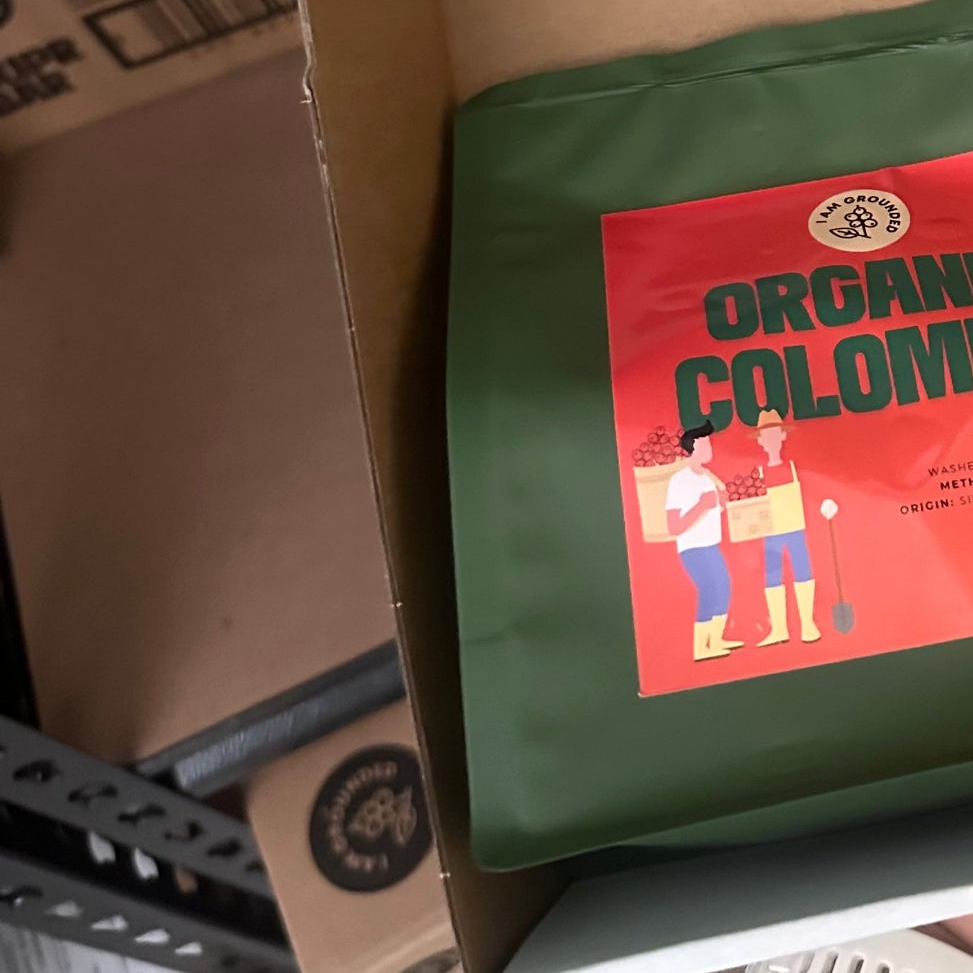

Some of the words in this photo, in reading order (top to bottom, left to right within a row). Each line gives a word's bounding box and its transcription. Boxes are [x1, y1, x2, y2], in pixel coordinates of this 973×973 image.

[820, 203, 842, 218] AM
[844, 195, 901, 233] GROUNDED
[900, 499, 954, 515] ORIGIN:
